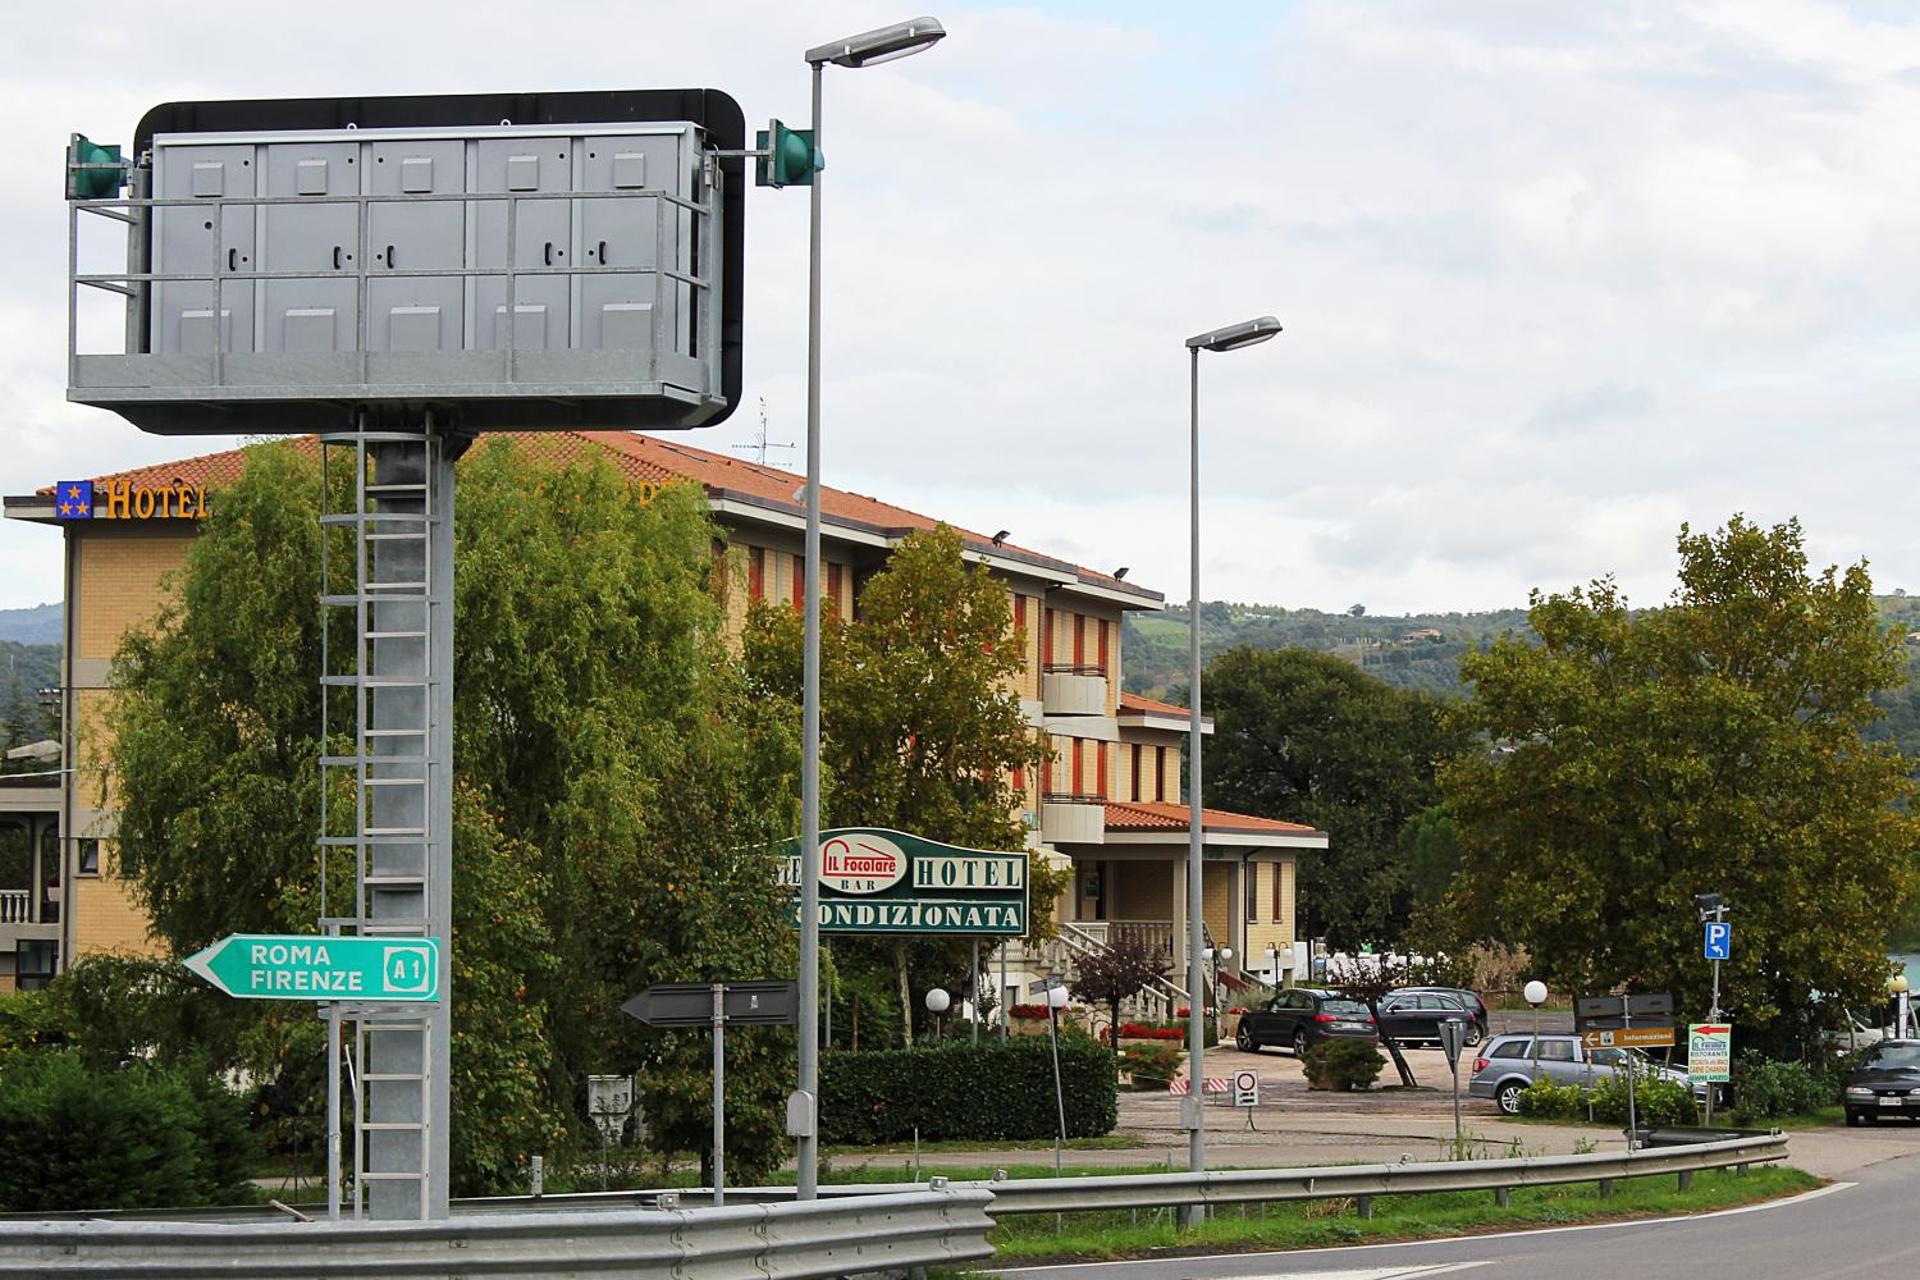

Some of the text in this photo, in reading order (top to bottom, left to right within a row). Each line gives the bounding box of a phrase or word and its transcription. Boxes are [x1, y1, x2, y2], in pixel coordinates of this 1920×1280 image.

[828, 856, 896, 872] IL Focolare
[917, 860, 1020, 887] HOTEL
[841, 880, 875, 890] BAR
[1710, 925, 1725, 944] P
[251, 944, 331, 965] ROMA
[251, 970, 363, 991] FIRENZE
